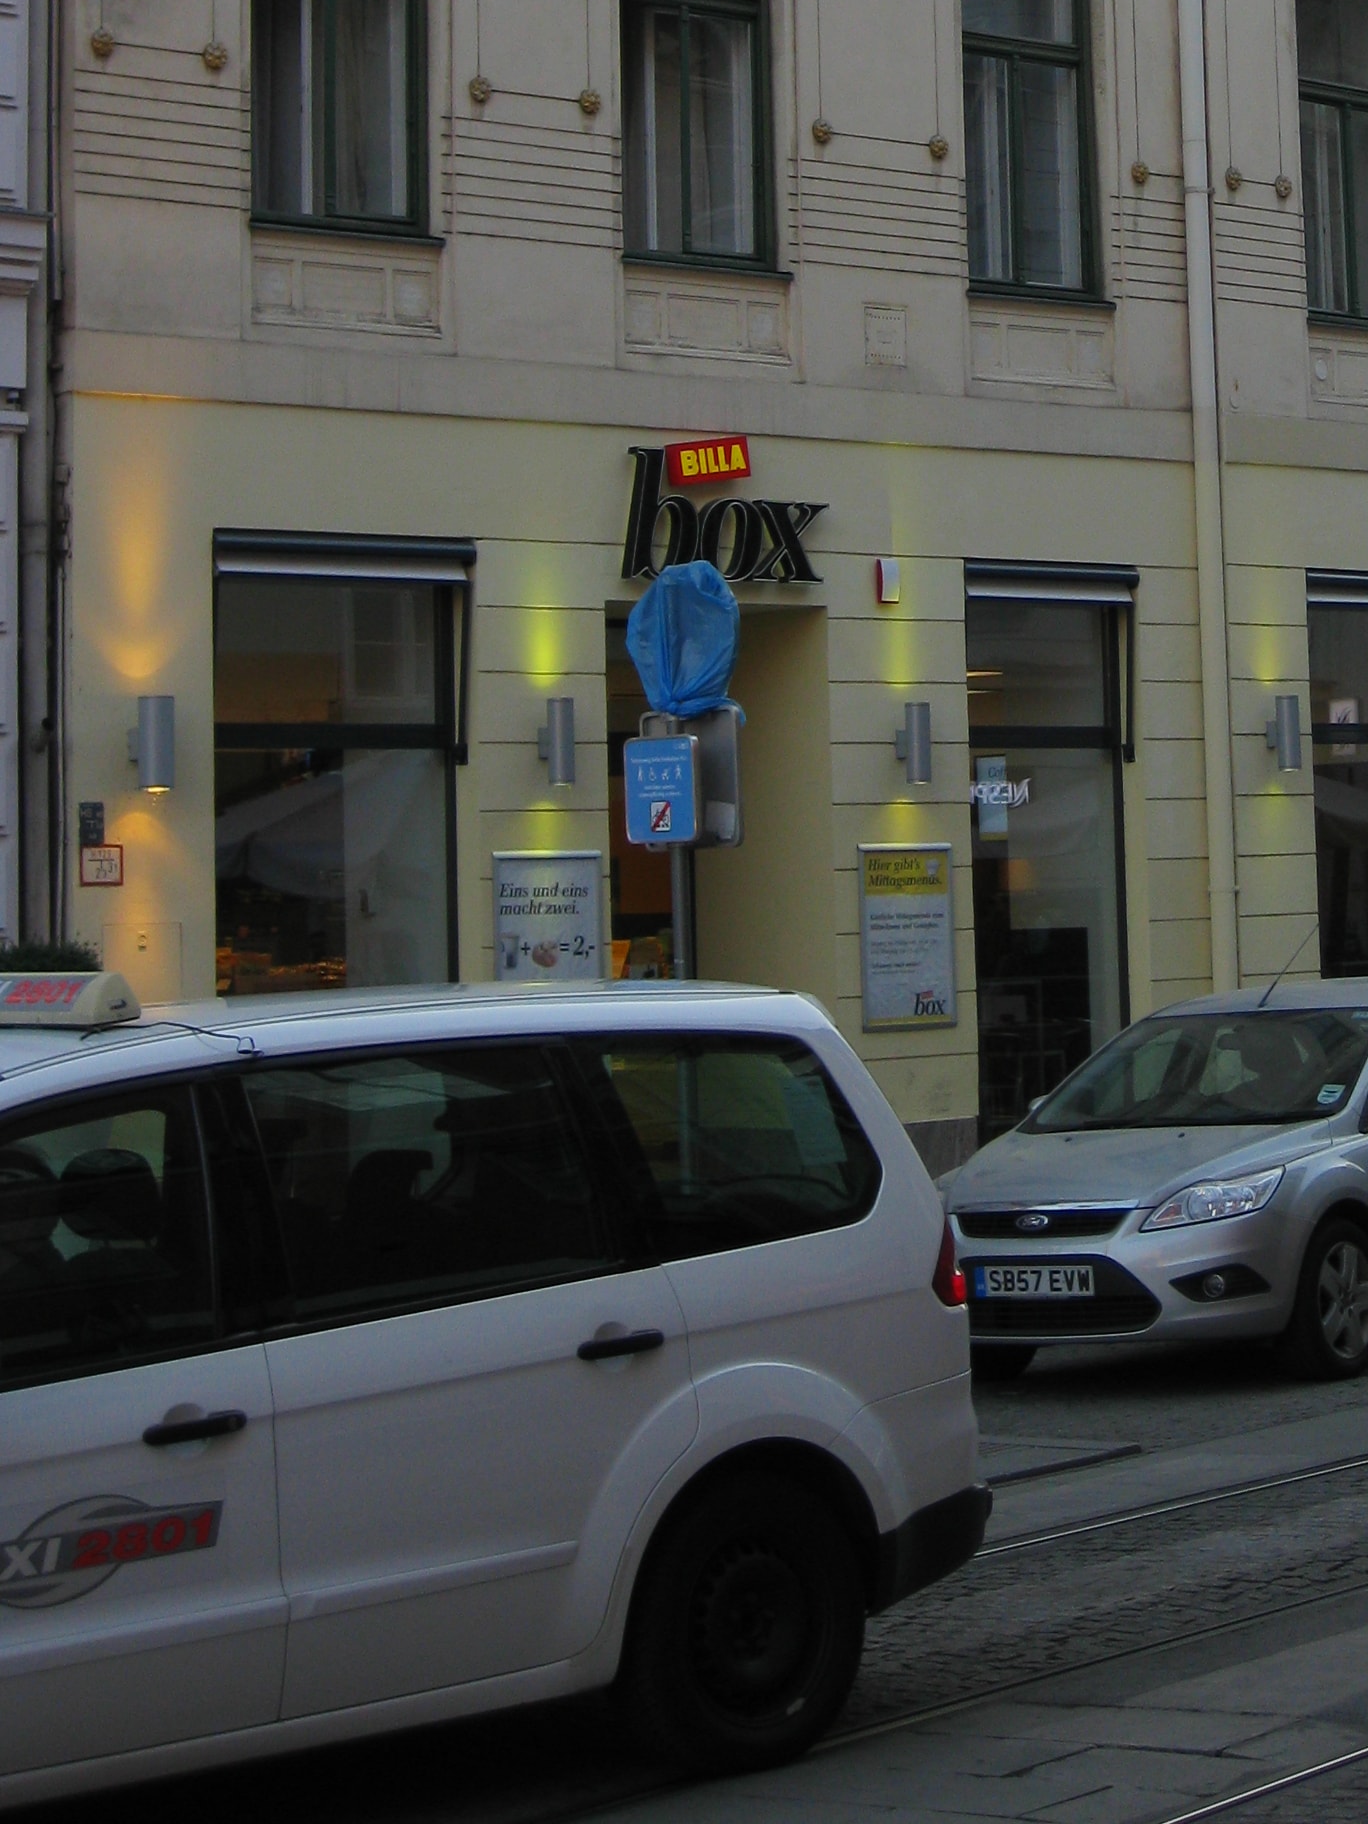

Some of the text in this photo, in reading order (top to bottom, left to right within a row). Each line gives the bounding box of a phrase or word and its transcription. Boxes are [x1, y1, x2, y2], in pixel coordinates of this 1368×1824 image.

[680, 444, 747, 477] BILLA
[621, 445, 830, 583] box
[868, 858, 921, 873] Hier gibt's
[499, 882, 589, 898] Eins und eins
[499, 899, 580, 915] macht zwei.
[5, 980, 84, 1005] 2801
[914, 992, 946, 1017] box
[988, 1269, 1090, 1292] SB57 EVW
[72, 1508, 216, 1570] 2801
